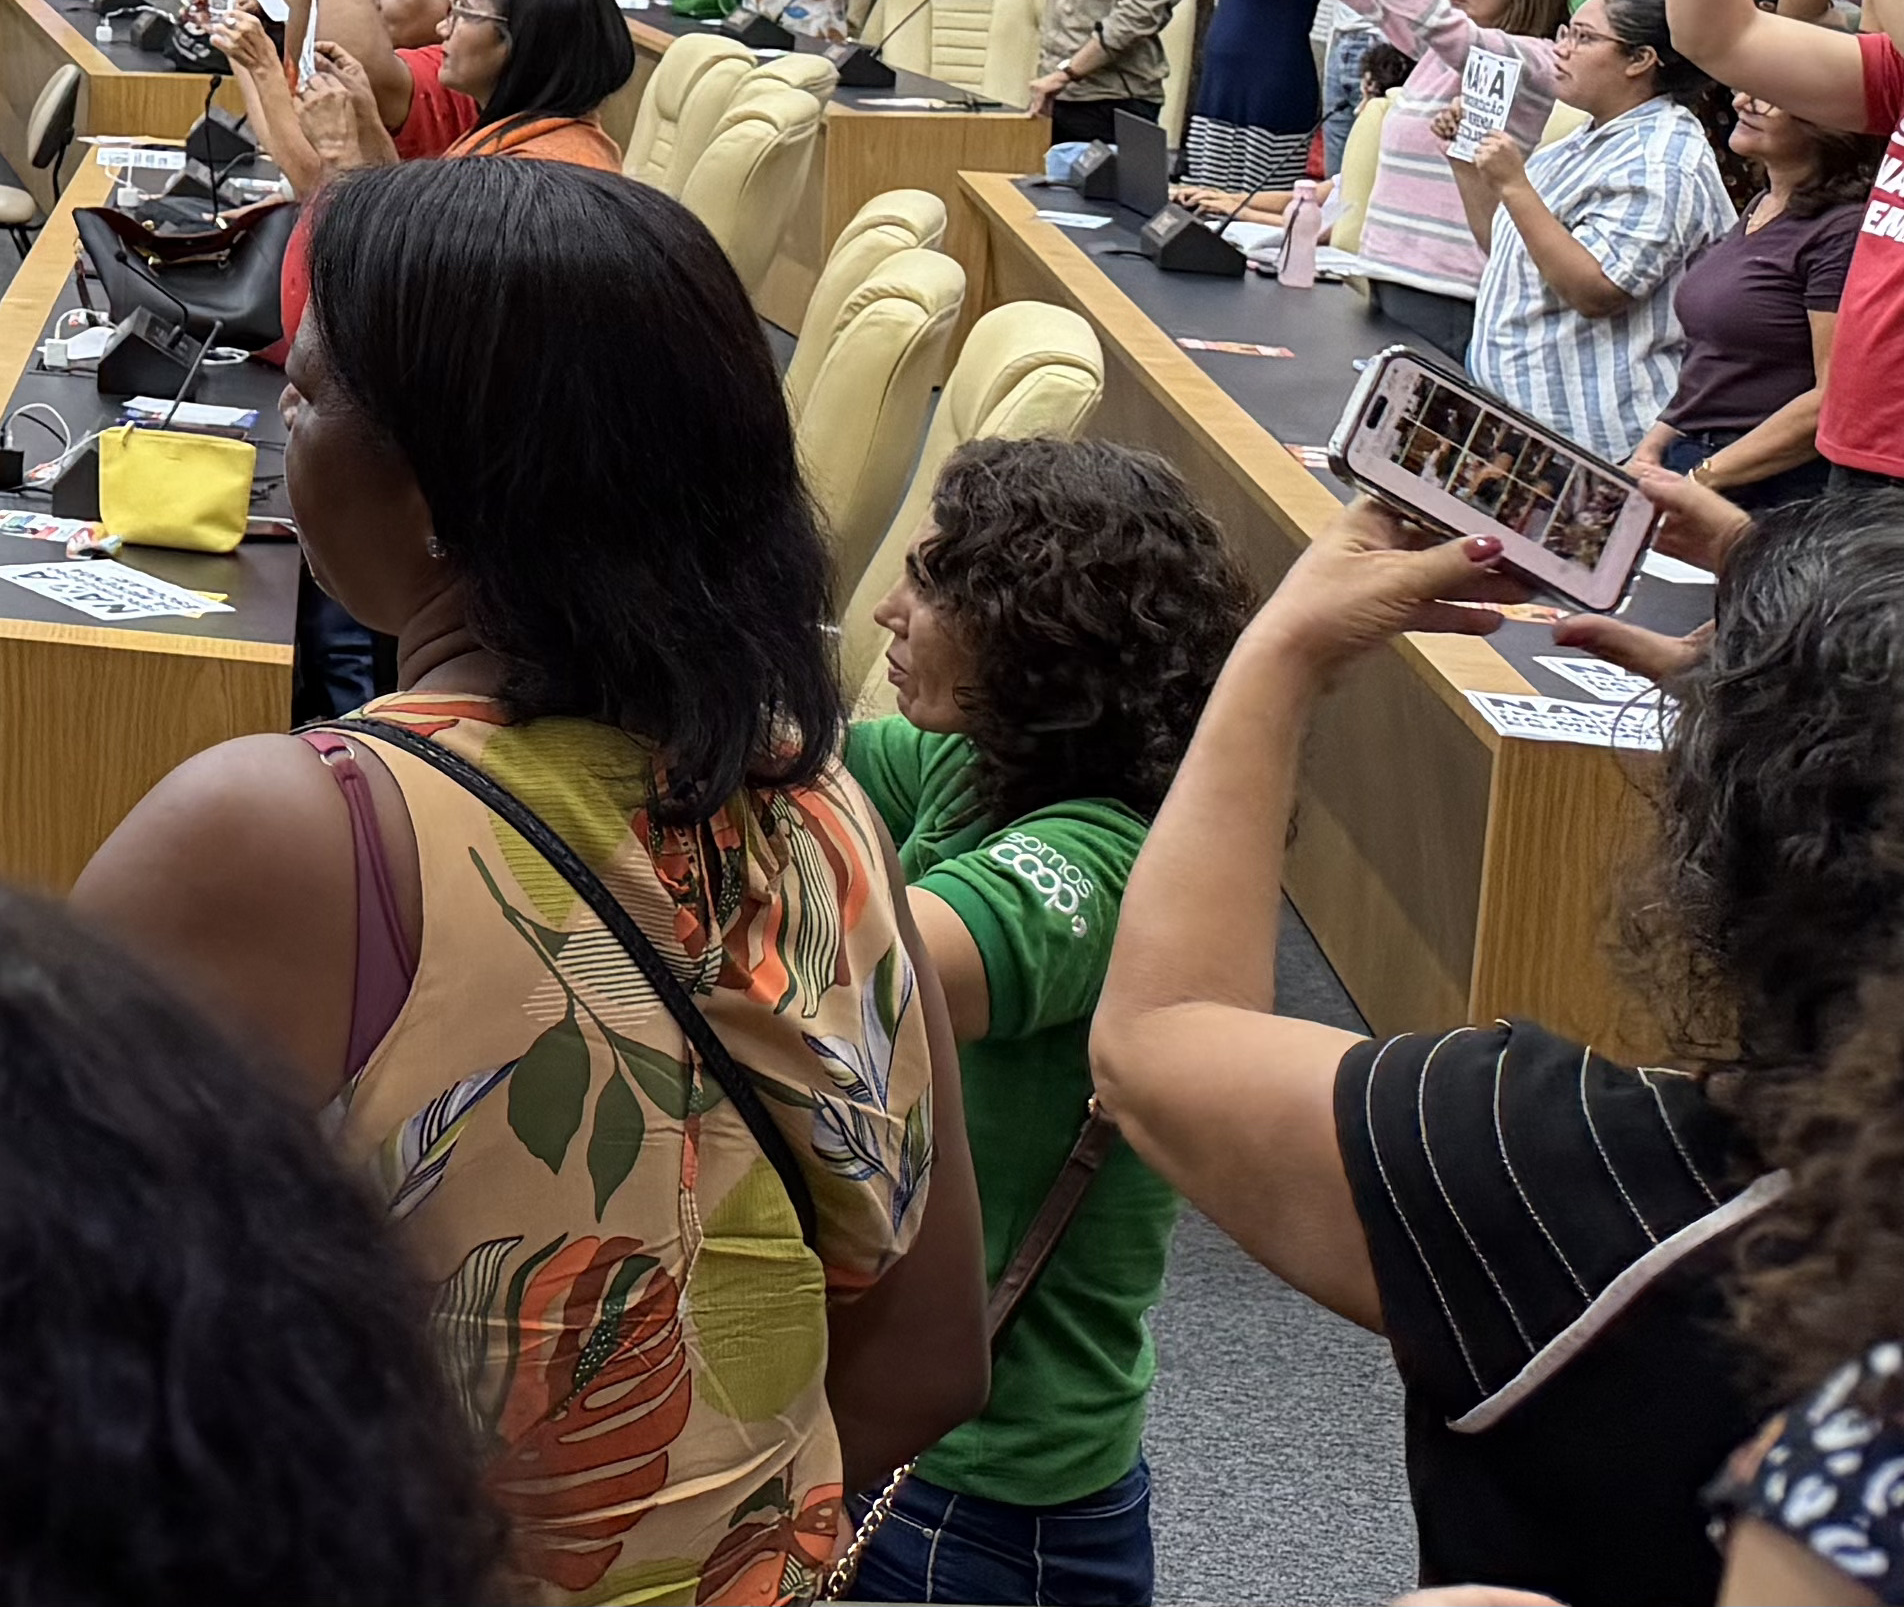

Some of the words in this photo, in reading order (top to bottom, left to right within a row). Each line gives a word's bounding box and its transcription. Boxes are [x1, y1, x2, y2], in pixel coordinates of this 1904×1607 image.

[1488, 61, 1505, 101] À
[989, 842, 1079, 915] coop
[1003, 831, 1094, 899] somos
